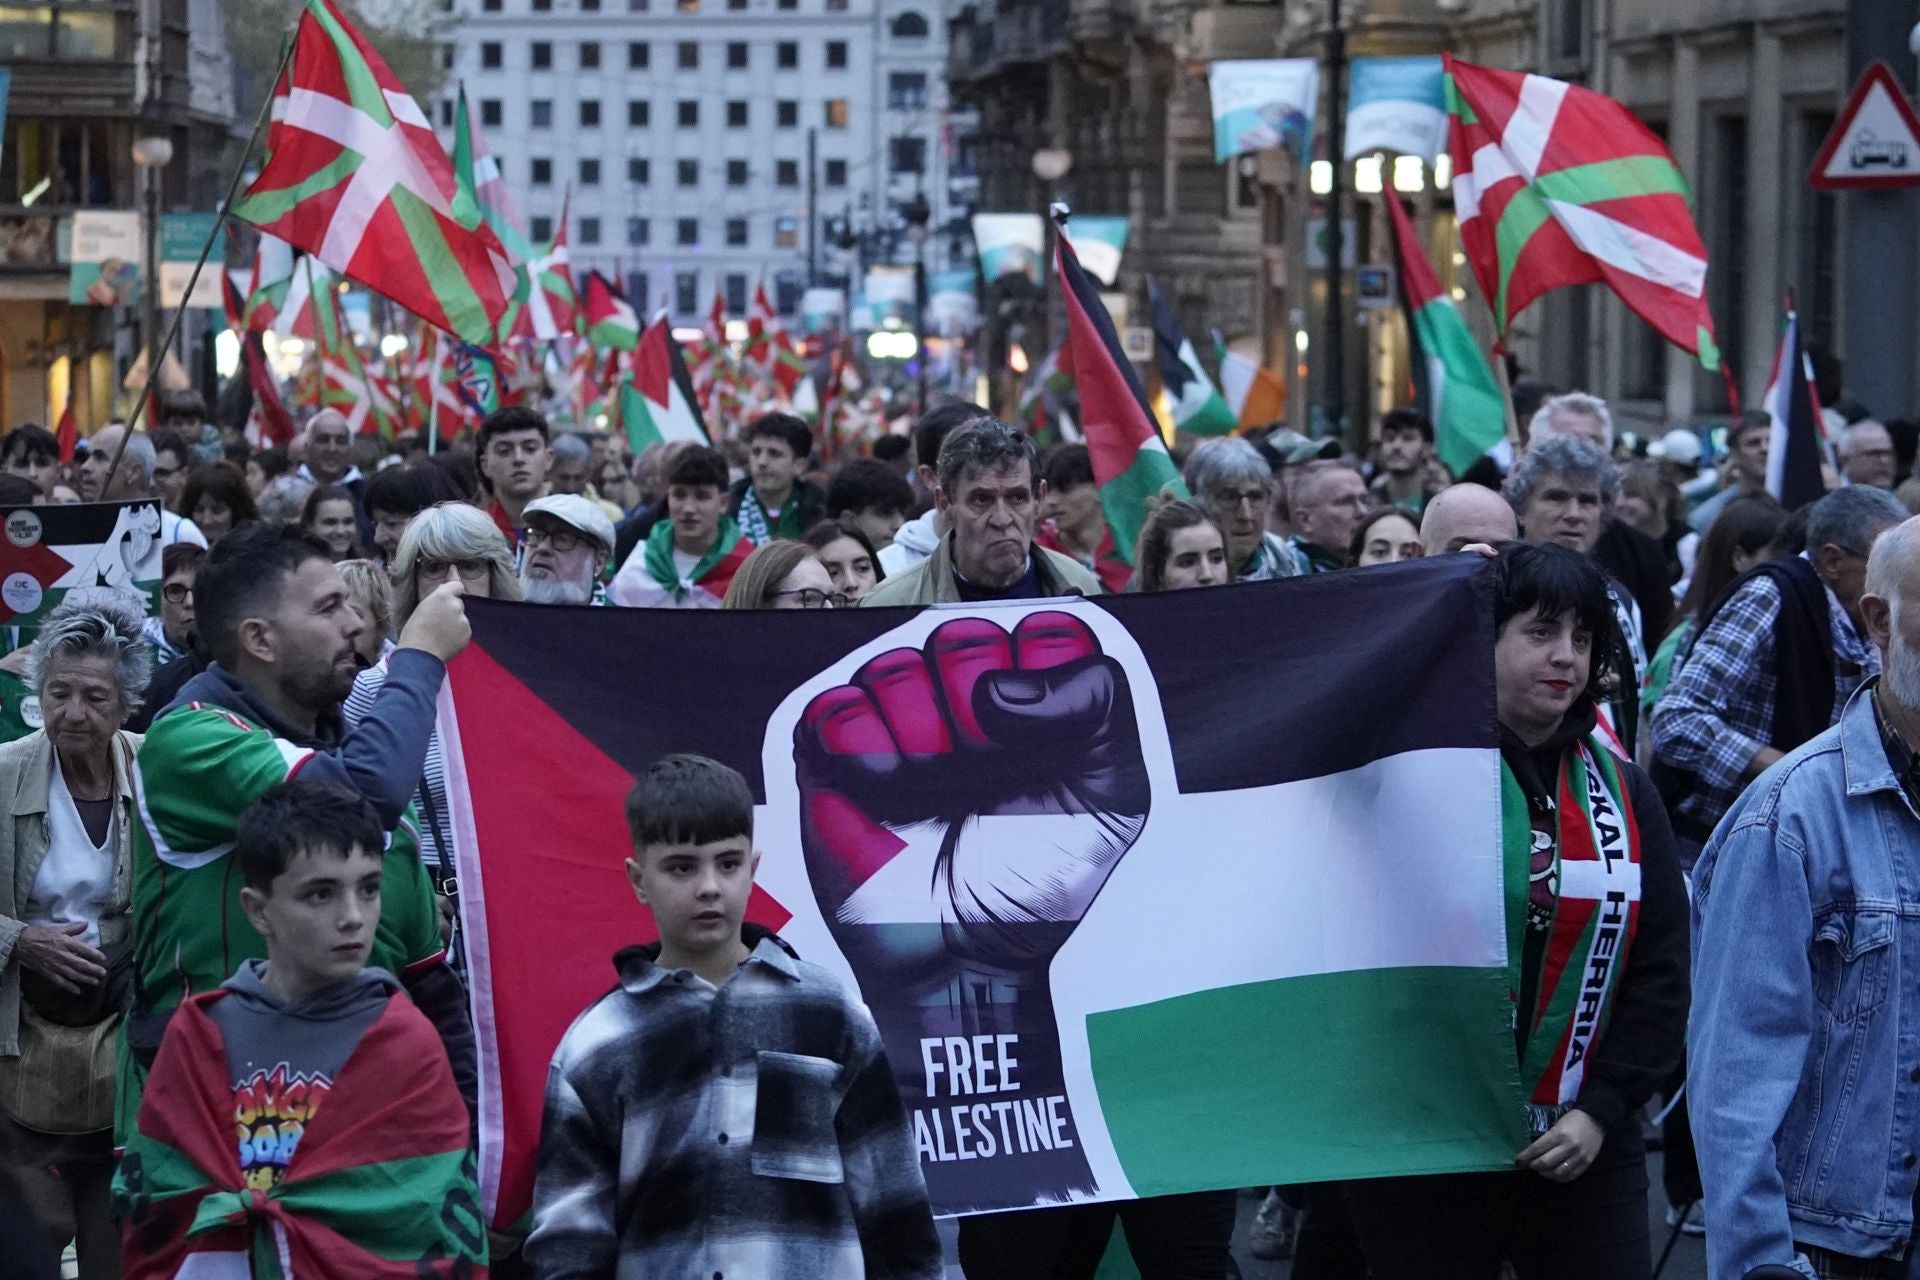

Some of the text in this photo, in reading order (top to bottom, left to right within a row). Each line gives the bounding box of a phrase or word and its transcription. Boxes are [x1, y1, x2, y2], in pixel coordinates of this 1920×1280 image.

[1566, 764, 1625, 1072] SKAL HERRIA
[920, 1034, 1021, 1098] FREE
[914, 1095, 1074, 1162] ALESTINE
